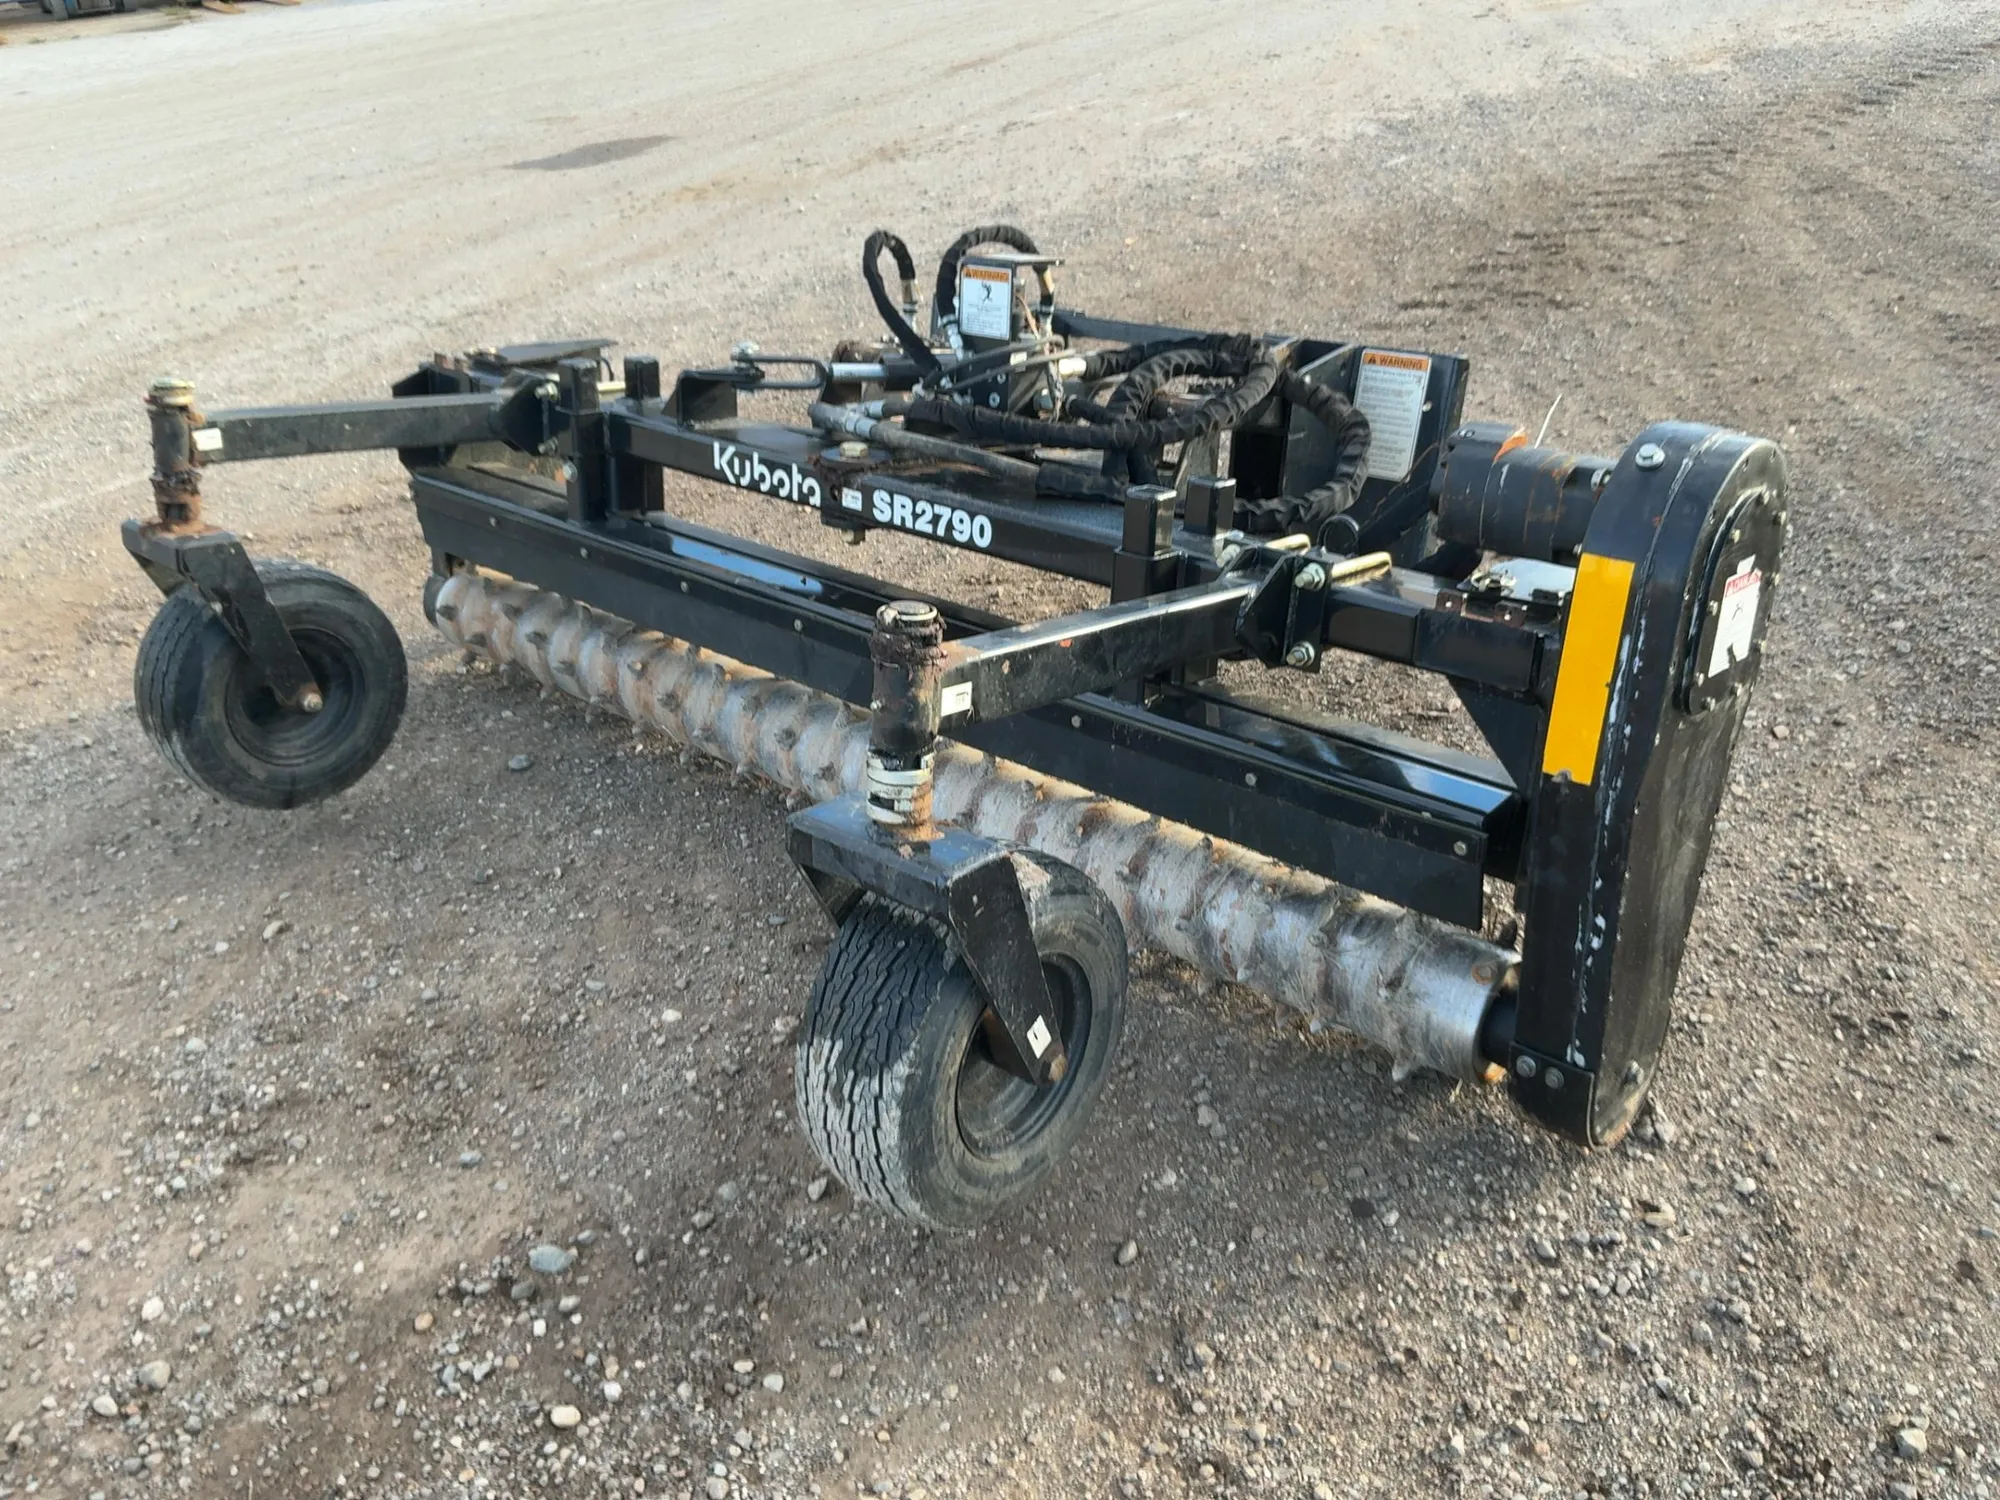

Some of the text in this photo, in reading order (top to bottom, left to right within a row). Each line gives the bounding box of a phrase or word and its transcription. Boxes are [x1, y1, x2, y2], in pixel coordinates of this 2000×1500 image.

[1379, 355, 1423, 370] WARNING
[713, 441, 821, 508] Kubota
[873, 489, 992, 548] SR2790
